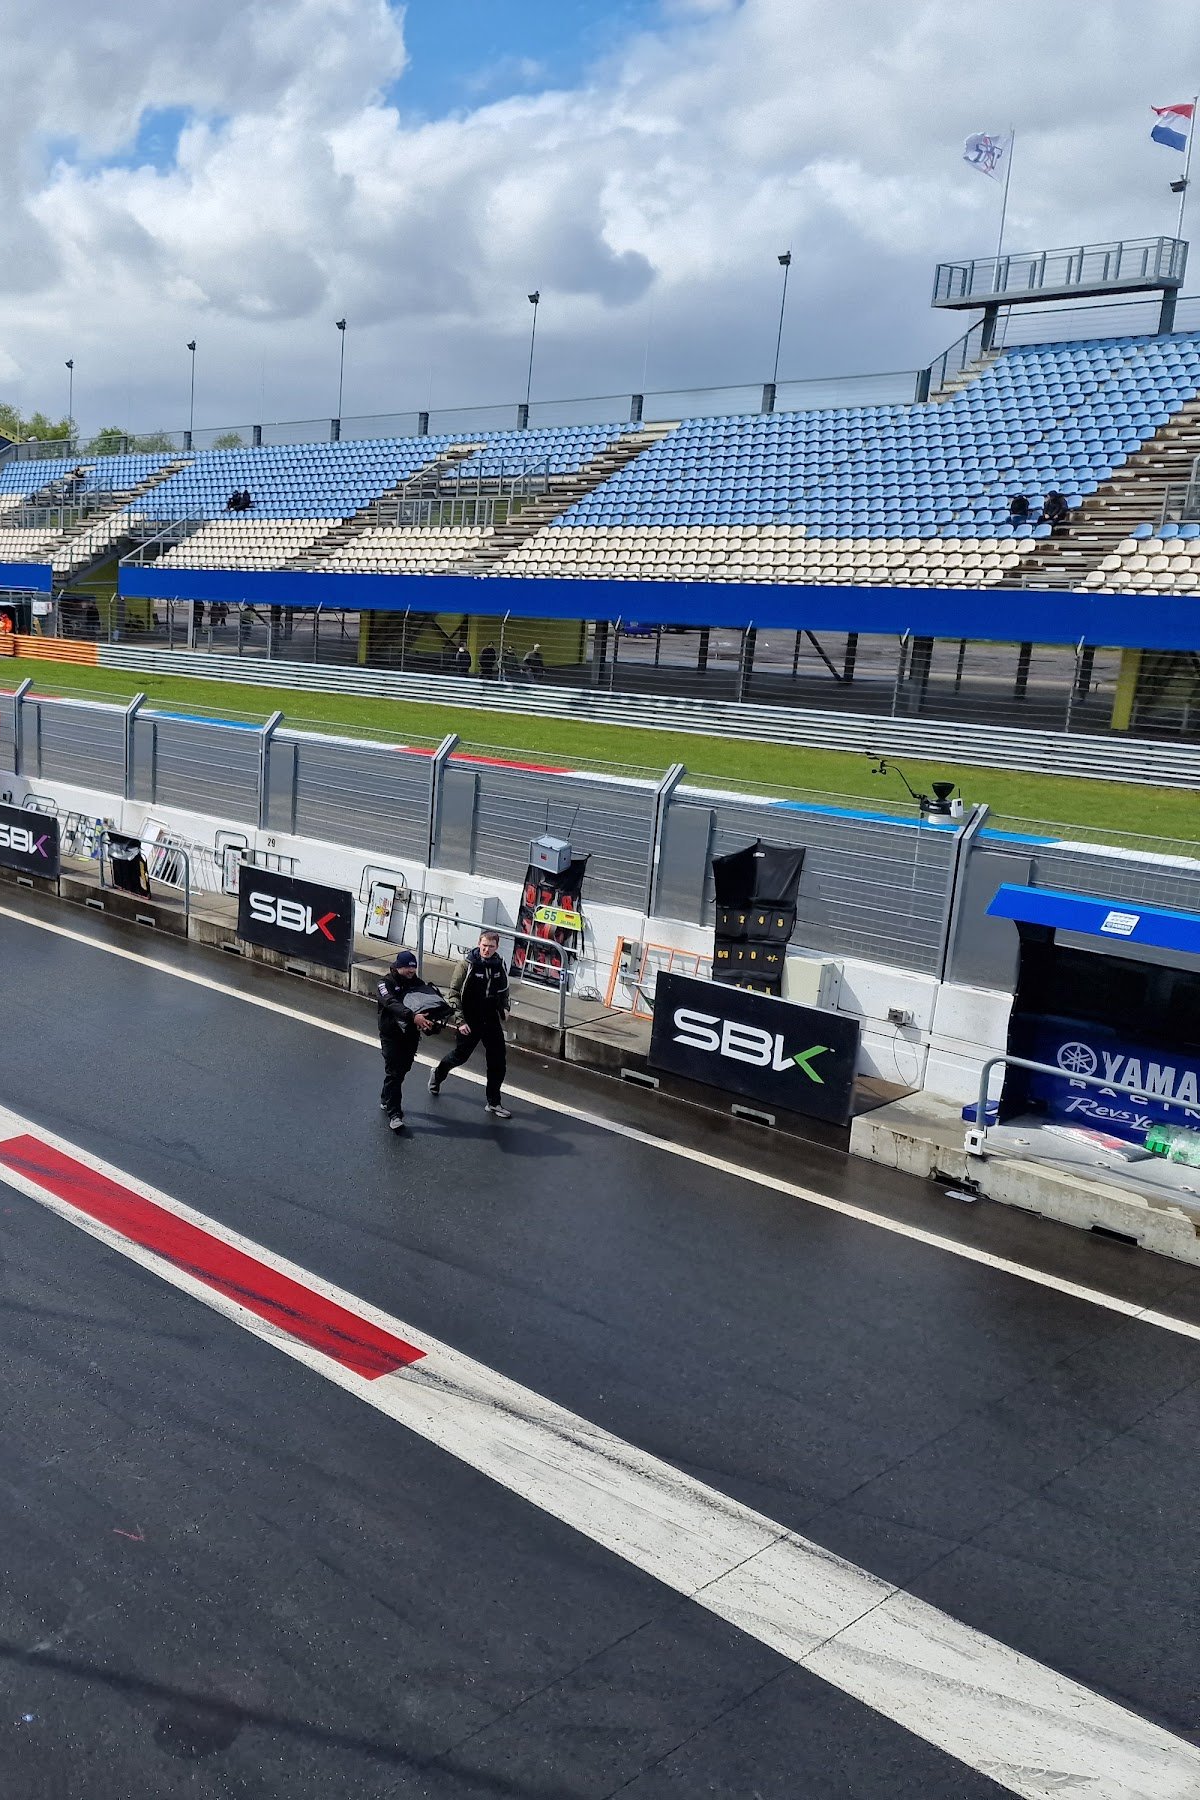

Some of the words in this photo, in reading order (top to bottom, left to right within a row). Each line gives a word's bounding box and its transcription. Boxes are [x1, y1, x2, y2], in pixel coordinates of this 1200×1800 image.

[267, 837, 276, 848] 29
[249, 891, 337, 942] SBK
[543, 910, 557, 922] 55
[739, 915, 745, 924] 2
[758, 915, 765, 925] 4
[777, 918, 784, 928] 5
[672, 1008, 830, 1085] SBK
[1101, 1050, 1199, 1106] YAMA
[1064, 1095, 1133, 1125] Revs
